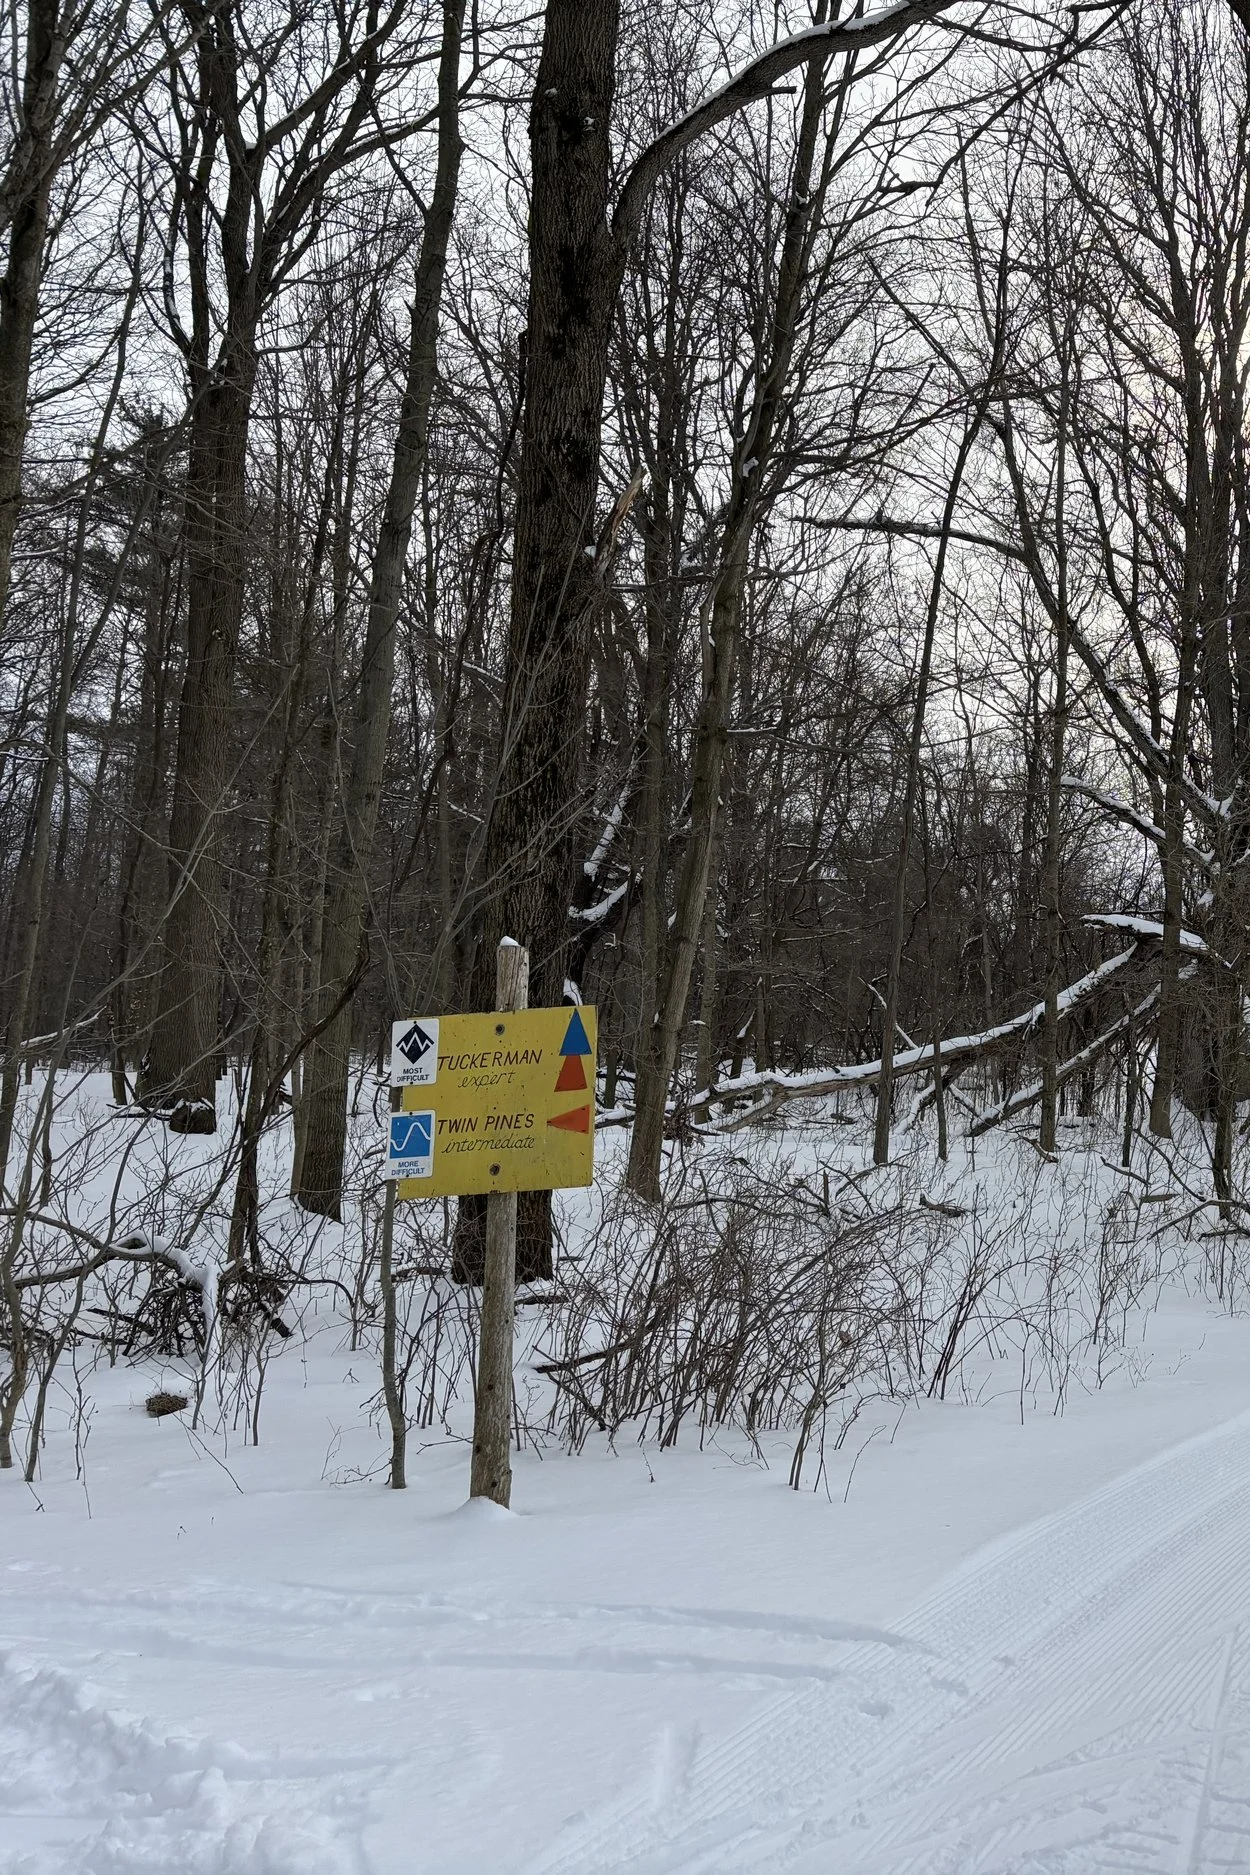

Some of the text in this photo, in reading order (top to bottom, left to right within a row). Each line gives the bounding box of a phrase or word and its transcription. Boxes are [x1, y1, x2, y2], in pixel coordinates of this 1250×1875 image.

[438, 1049, 543, 1071] TUCKERMAN
[396, 1074, 430, 1082] DIFFICULT
[402, 1067, 423, 1075] MOST
[457, 1070, 516, 1092] expert
[437, 1113, 534, 1135] TWIN PINES
[441, 1134, 535, 1154] intermediate
[391, 1167, 425, 1176] DIFFICULT
